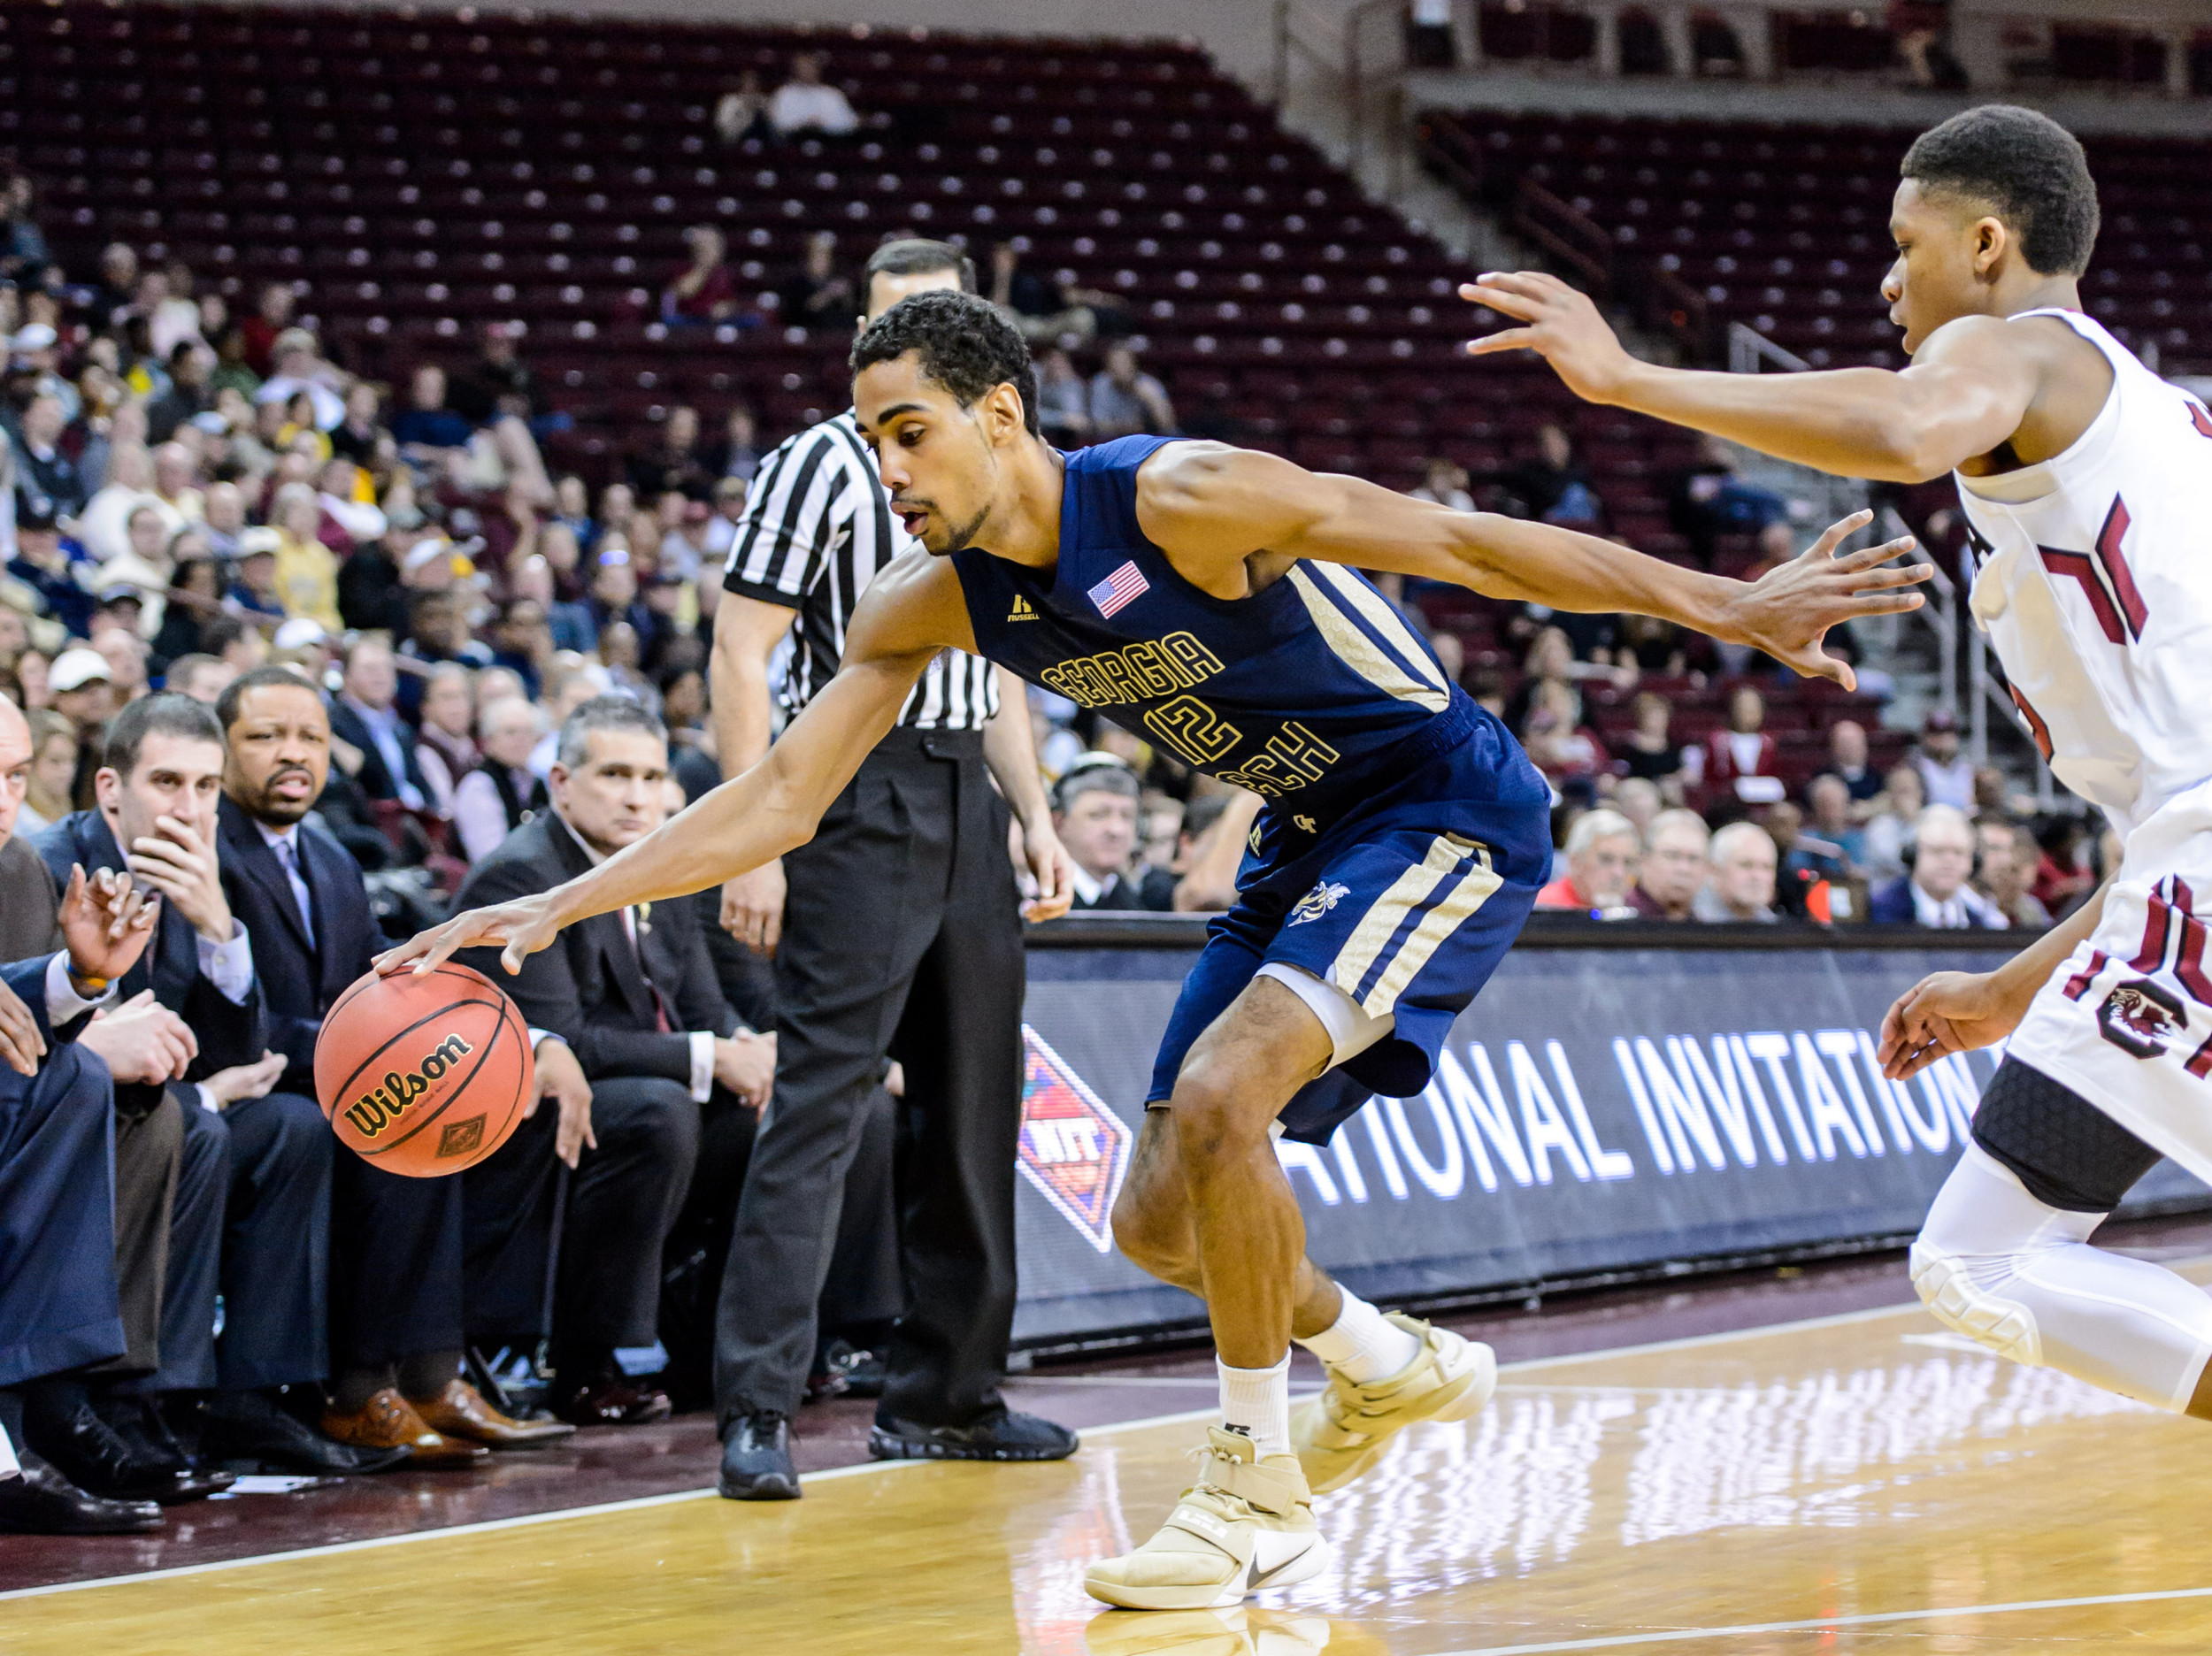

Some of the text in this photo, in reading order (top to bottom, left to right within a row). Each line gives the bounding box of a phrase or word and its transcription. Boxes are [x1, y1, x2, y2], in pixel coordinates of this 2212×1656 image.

[1007, 612, 1041, 623] RUSSELL
[1041, 631, 1225, 708] GEORGIA
[343, 1032, 474, 1138] Wilson
[1273, 1038, 1635, 1206] IONAL
[1025, 1117, 1101, 1164] NIT
